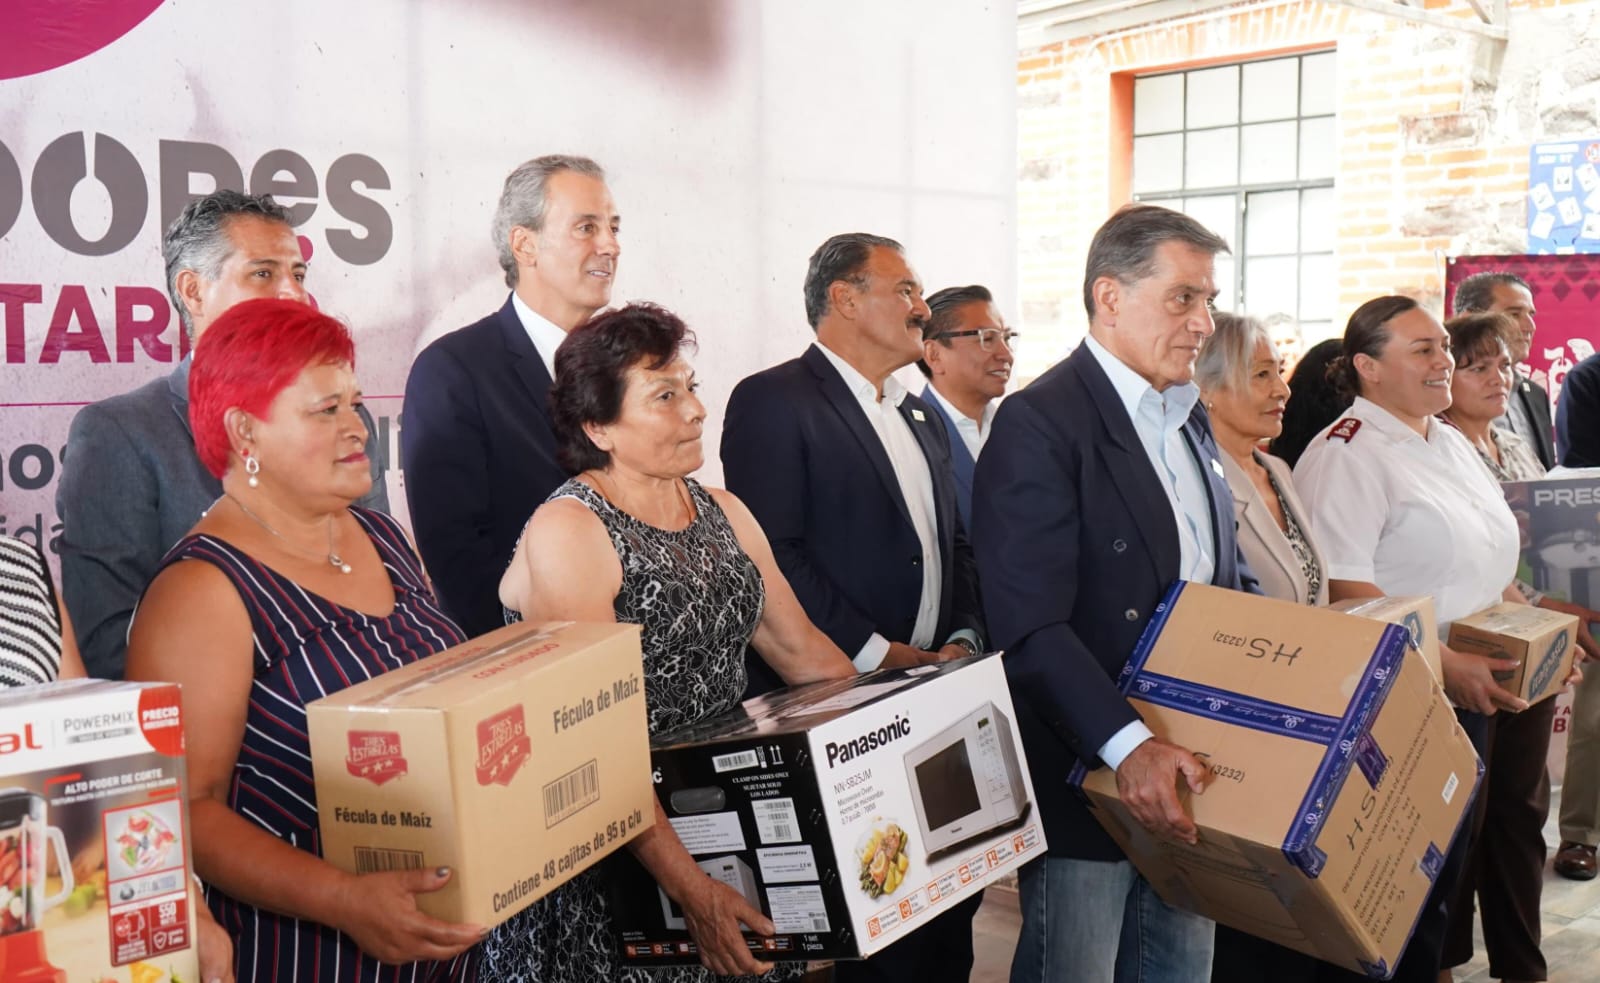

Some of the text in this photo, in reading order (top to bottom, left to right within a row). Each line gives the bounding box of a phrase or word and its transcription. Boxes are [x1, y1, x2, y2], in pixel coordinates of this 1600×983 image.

[1213, 629, 1303, 667] HS (3232)
[143, 706, 179, 722] PRECIO
[553, 672, 640, 734] Fécula de Maíz
[64, 711, 135, 732] POWERMIX
[825, 714, 911, 769] Panasonic
[64, 782, 88, 795] ALTO
[89, 776, 120, 790] PODER
[121, 773, 133, 784] DE
[134, 767, 163, 781] CORTE
[1209, 764, 1246, 784] (3232)
[335, 807, 432, 828] Fécula de Maíz
[492, 808, 642, 913] Contiene 48 cajitas de 95 g c/u
